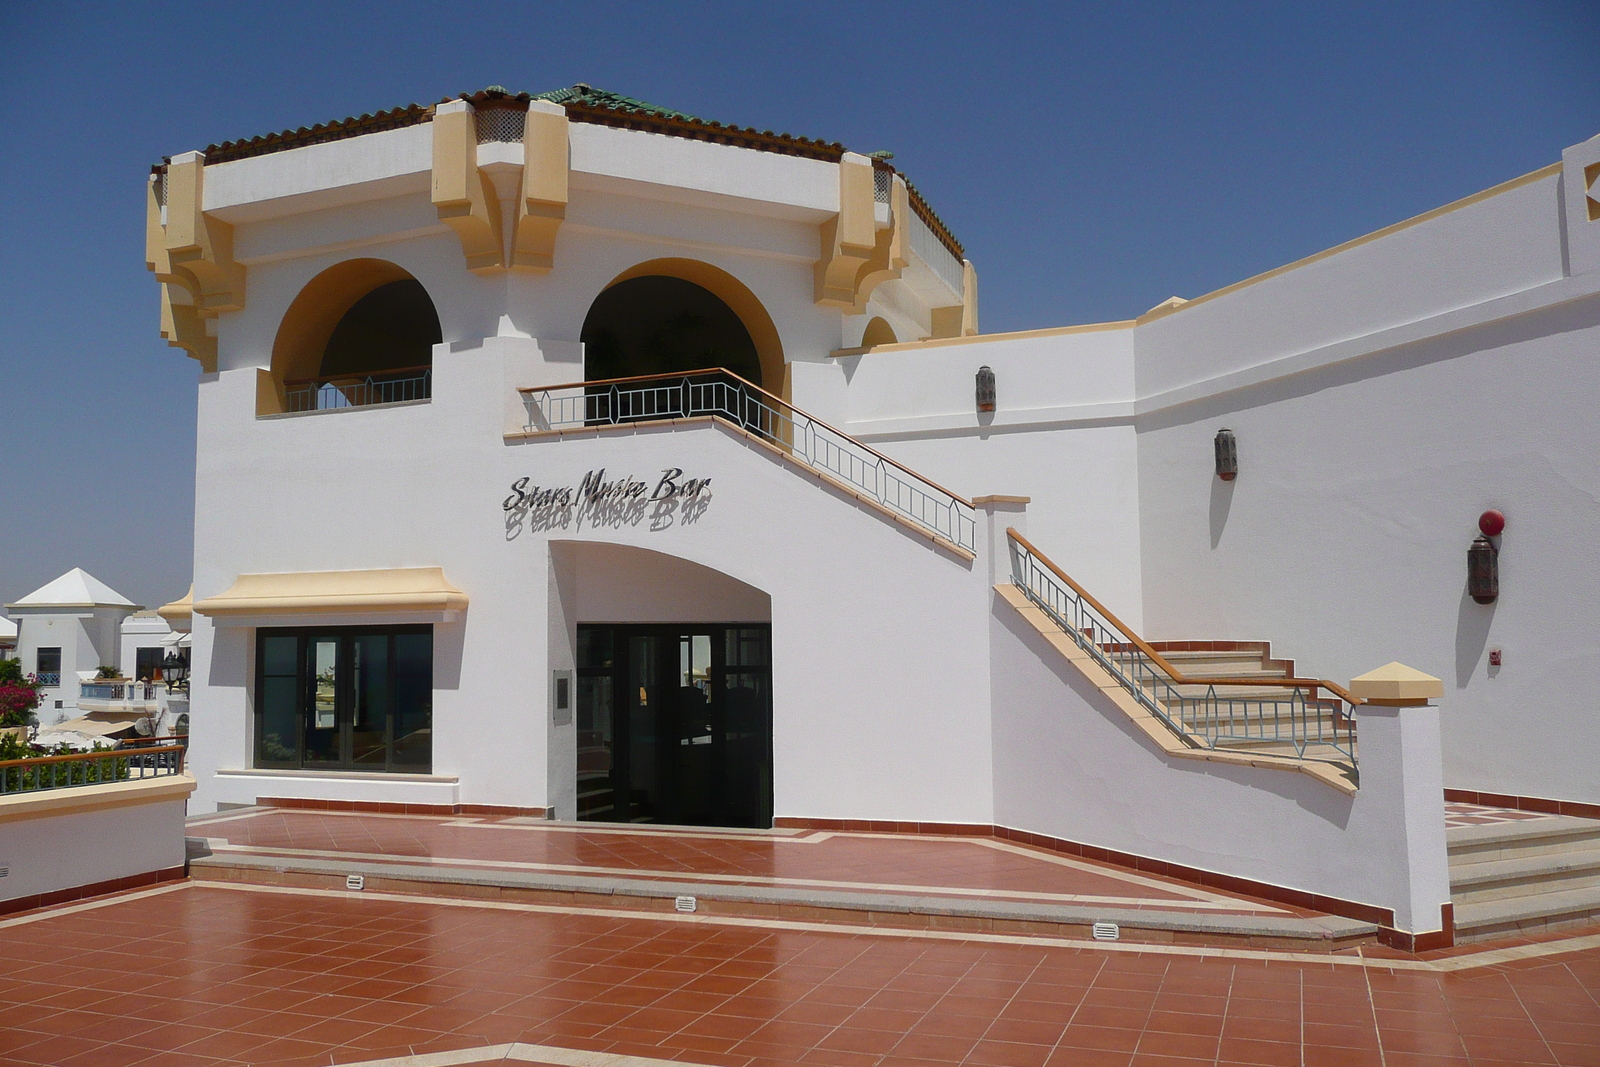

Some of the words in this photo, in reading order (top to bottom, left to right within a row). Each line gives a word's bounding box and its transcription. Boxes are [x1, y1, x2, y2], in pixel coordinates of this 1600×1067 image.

[503, 476, 573, 511] Stars
[575, 468, 647, 506] Music
[648, 468, 712, 502] Bar
